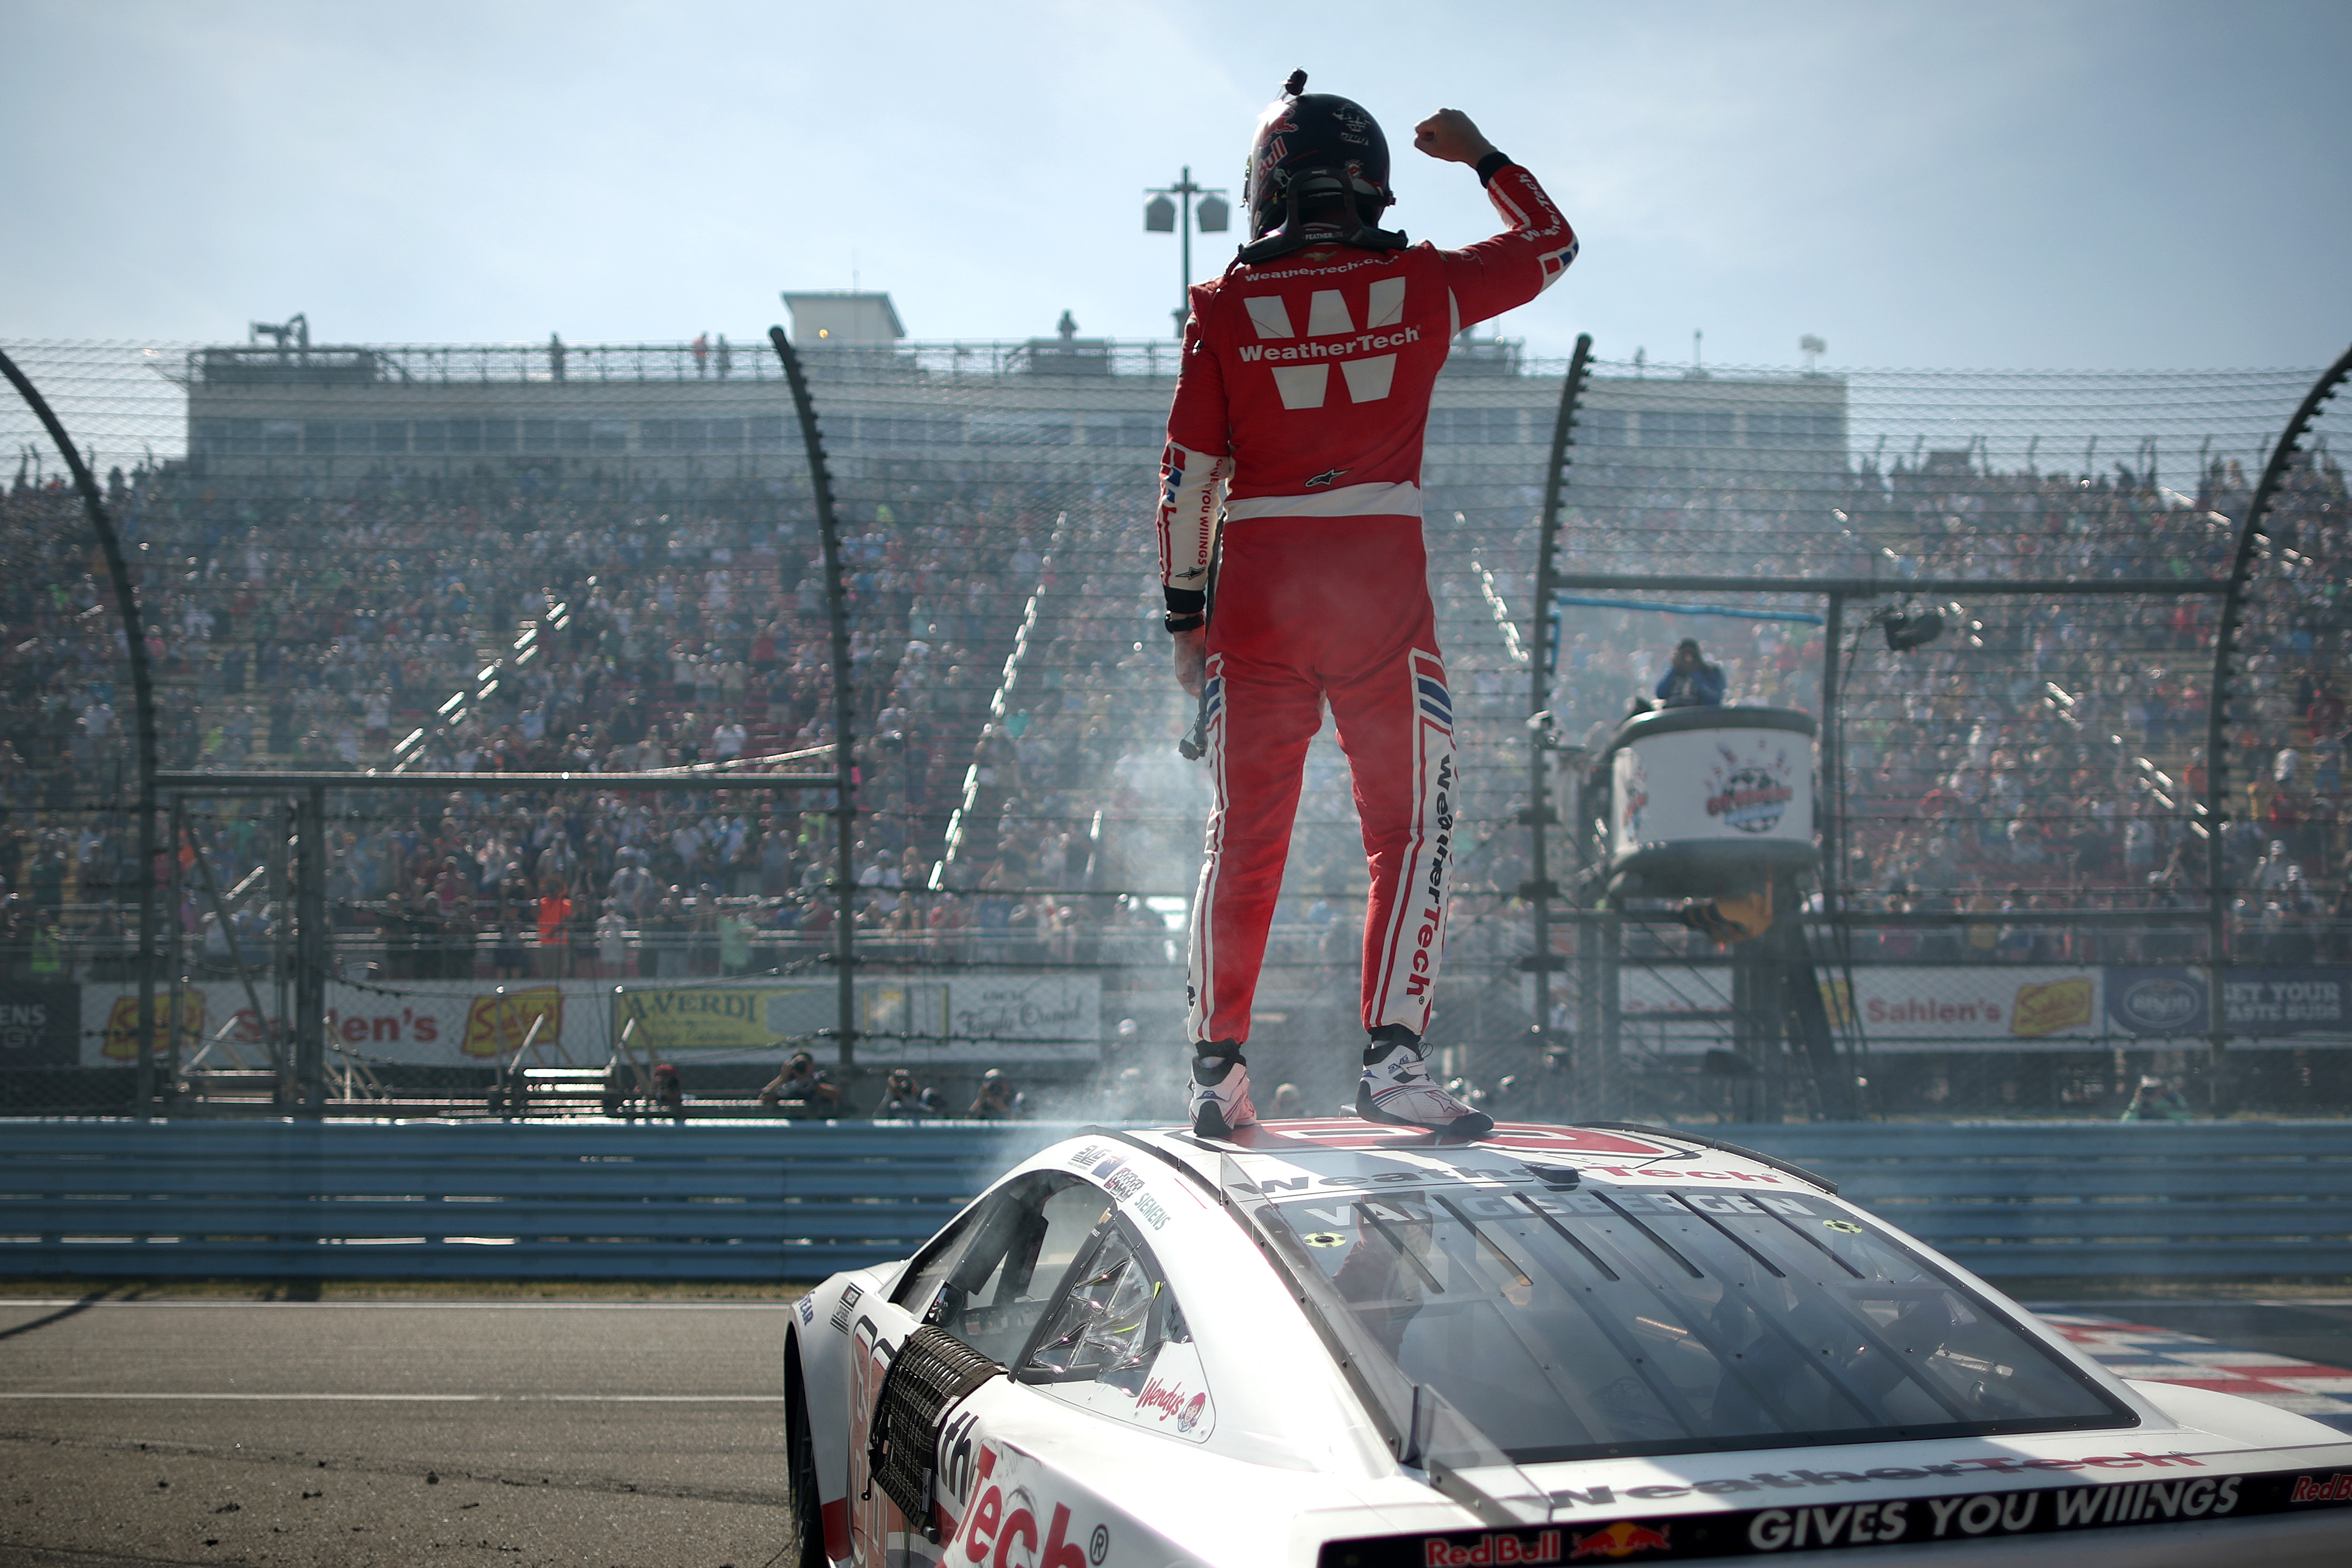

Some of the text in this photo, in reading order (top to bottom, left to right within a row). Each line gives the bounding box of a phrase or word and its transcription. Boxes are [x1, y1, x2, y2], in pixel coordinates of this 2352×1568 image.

[1257, 135, 1288, 183] Bull
[1239, 326, 1420, 362] WeatherTech
[1201, 489, 1212, 513] YOU
[1198, 516, 1209, 565] WIIINGS
[2271, 981, 2340, 1001] YOUR
[1866, 998, 2001, 1023] Sahlen's
[1134, 1192, 1171, 1231] SIEMENS
[1461, 1193, 1817, 1217] GISBERGEN
[1135, 1377, 1185, 1422] Wendy's
[2290, 1473, 2341, 1502] Red
[1749, 1476, 2242, 1552] GIVES YOU WIIINGS
[1425, 1530, 1561, 1567] Red Bull
